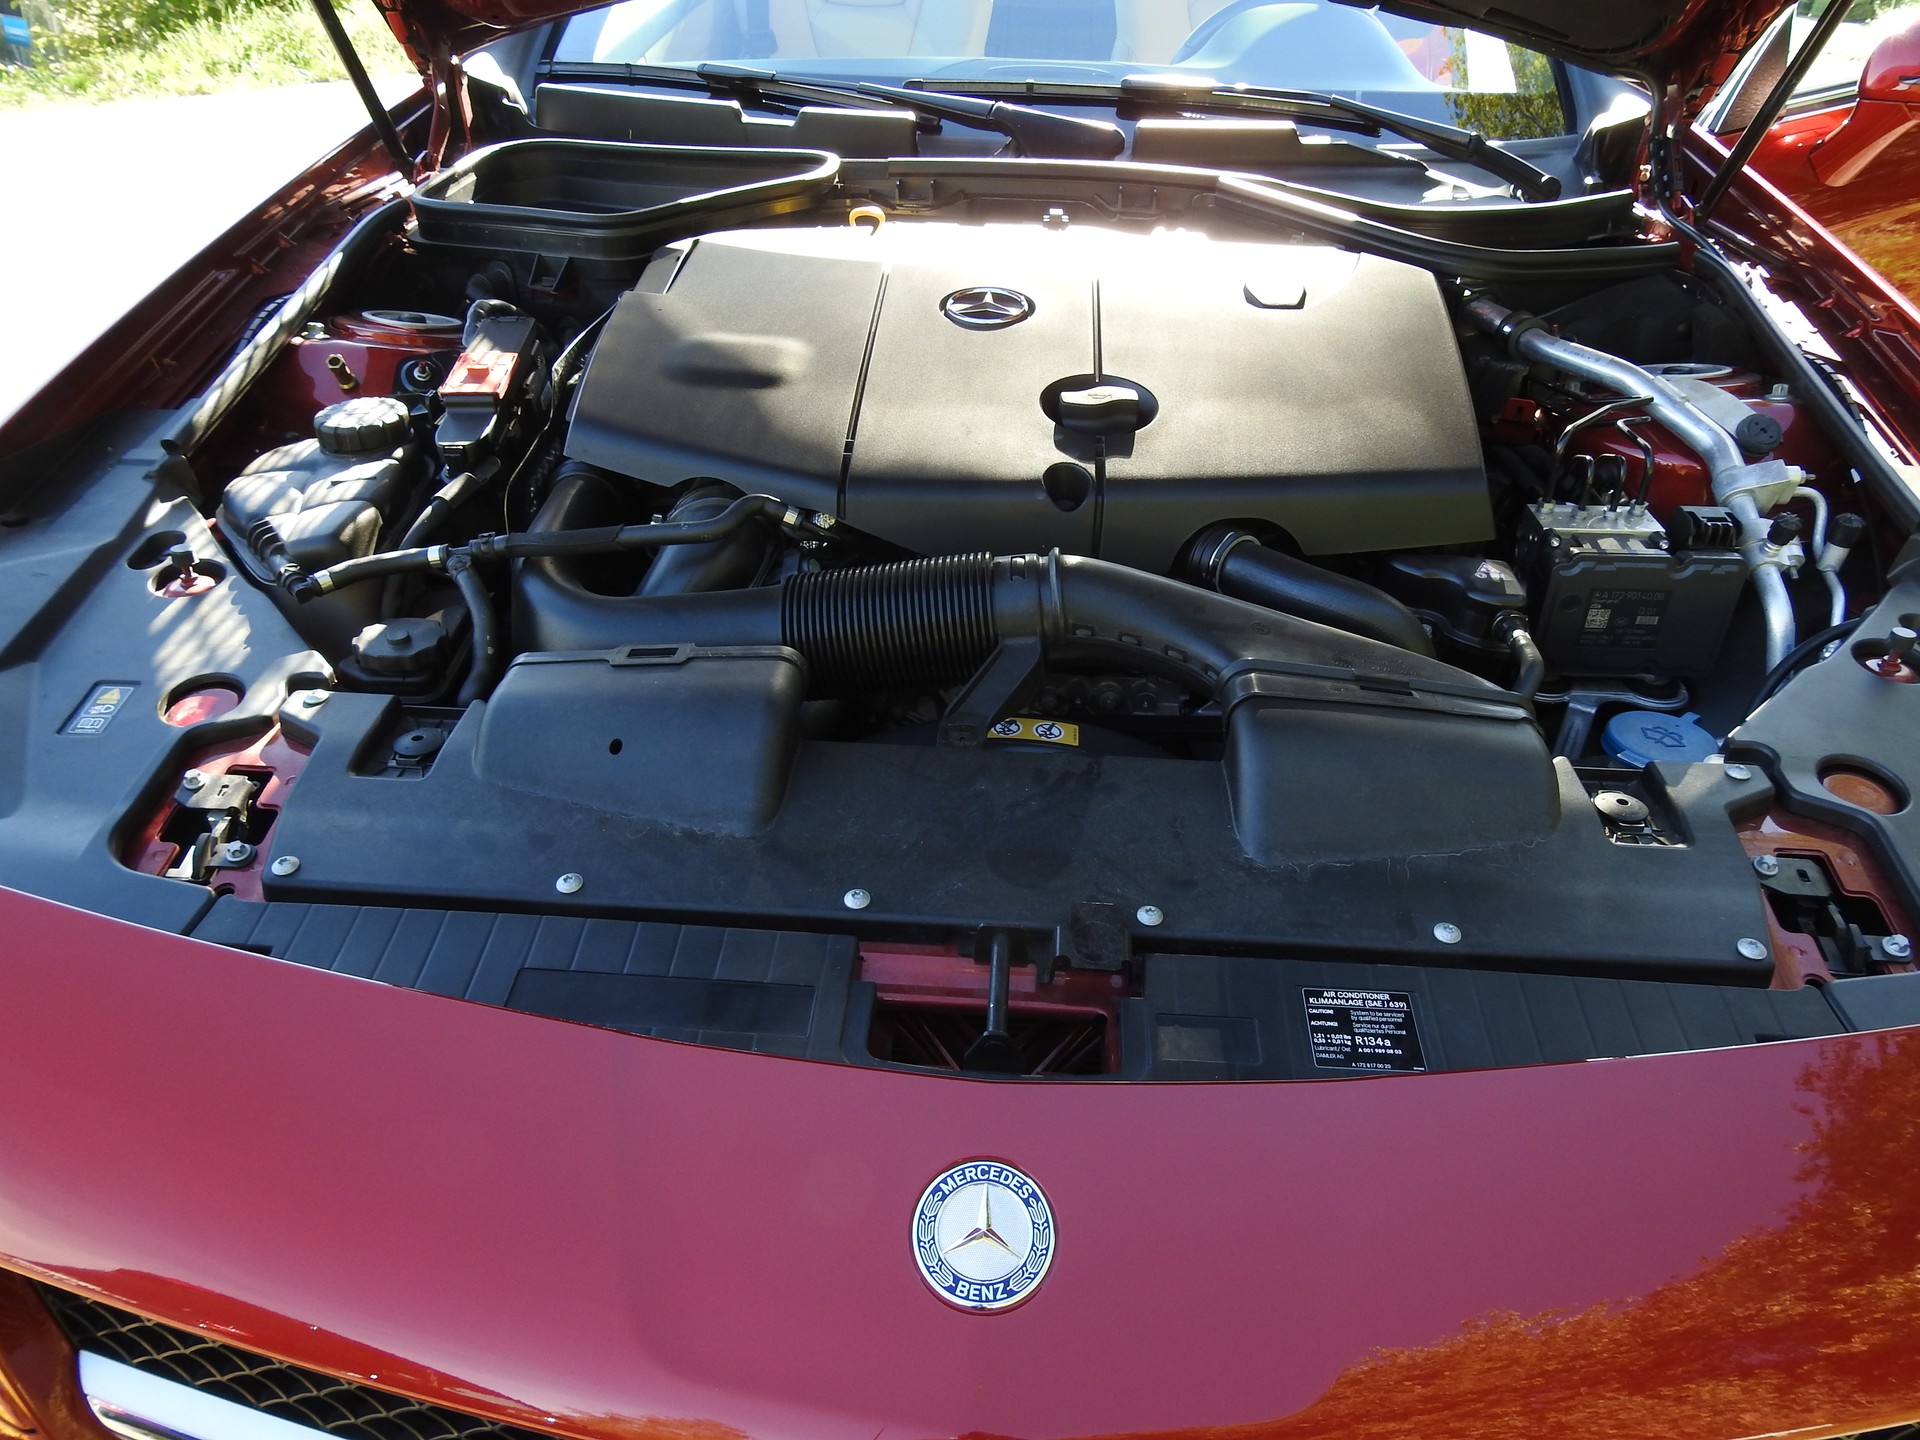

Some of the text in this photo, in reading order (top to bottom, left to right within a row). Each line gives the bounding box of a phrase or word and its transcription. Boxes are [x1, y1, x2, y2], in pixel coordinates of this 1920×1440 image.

[1337, 992, 1390, 1000] CONDITIONER
[1309, 998, 1364, 1006] KLIMAANLAGE
[1365, 1000, 1382, 1008] (SAE
[1389, 1001, 1406, 1010] 639)
[1355, 1036, 1392, 1046] R134a
[940, 1165, 1033, 1199] MERCEDES
[955, 1280, 1008, 1300] BENZ
